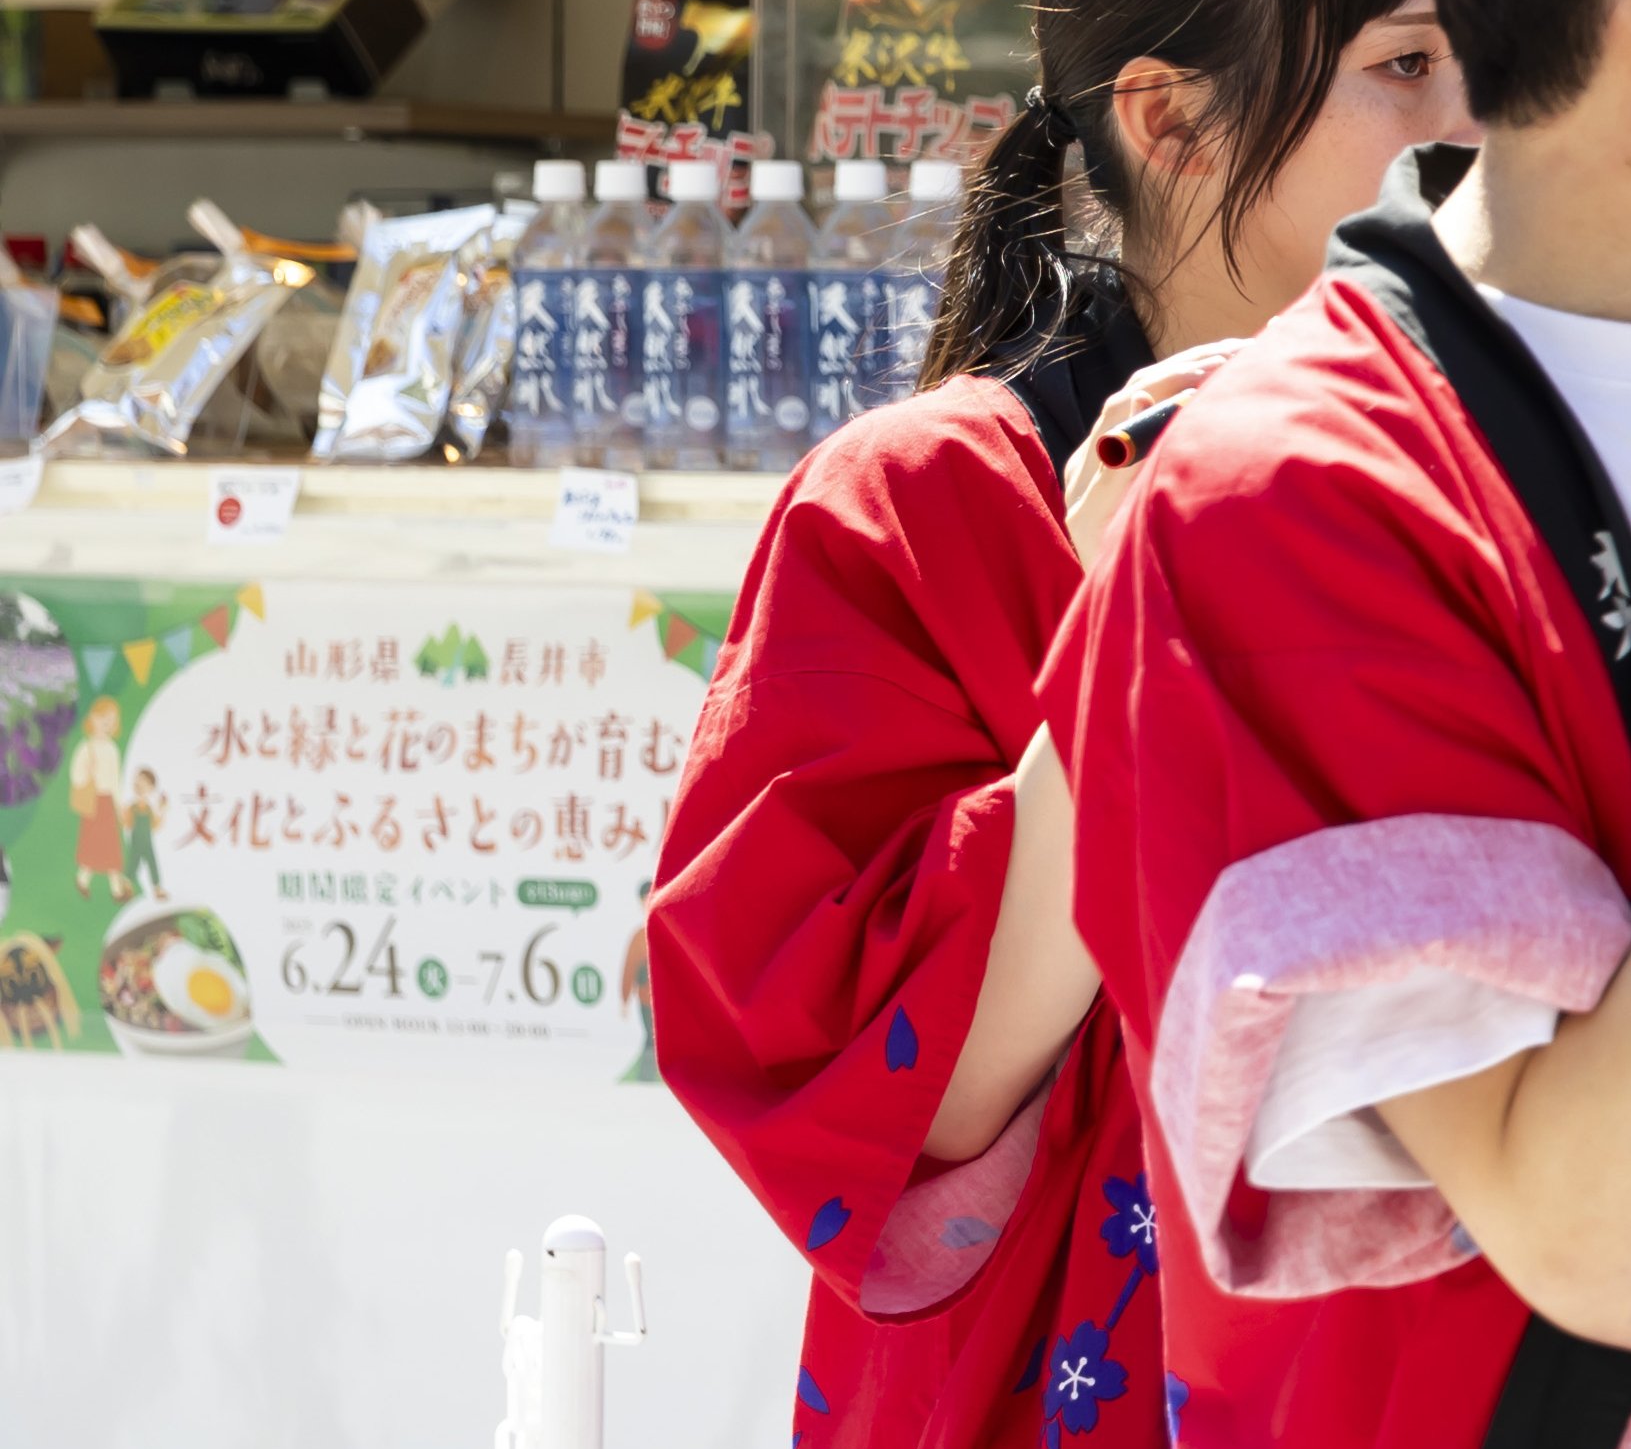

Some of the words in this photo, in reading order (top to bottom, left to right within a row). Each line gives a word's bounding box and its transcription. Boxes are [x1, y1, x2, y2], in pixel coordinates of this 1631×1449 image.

[283, 636, 400, 684] 山形県
[500, 636, 609, 688] 長井市
[200, 704, 686, 780] 水と緑と花のまちが育む
[175, 782, 672, 862] 文化とふるさとの恵み
[277, 871, 504, 906] 期間限定イベント
[477, 920, 565, 1008] 7.6
